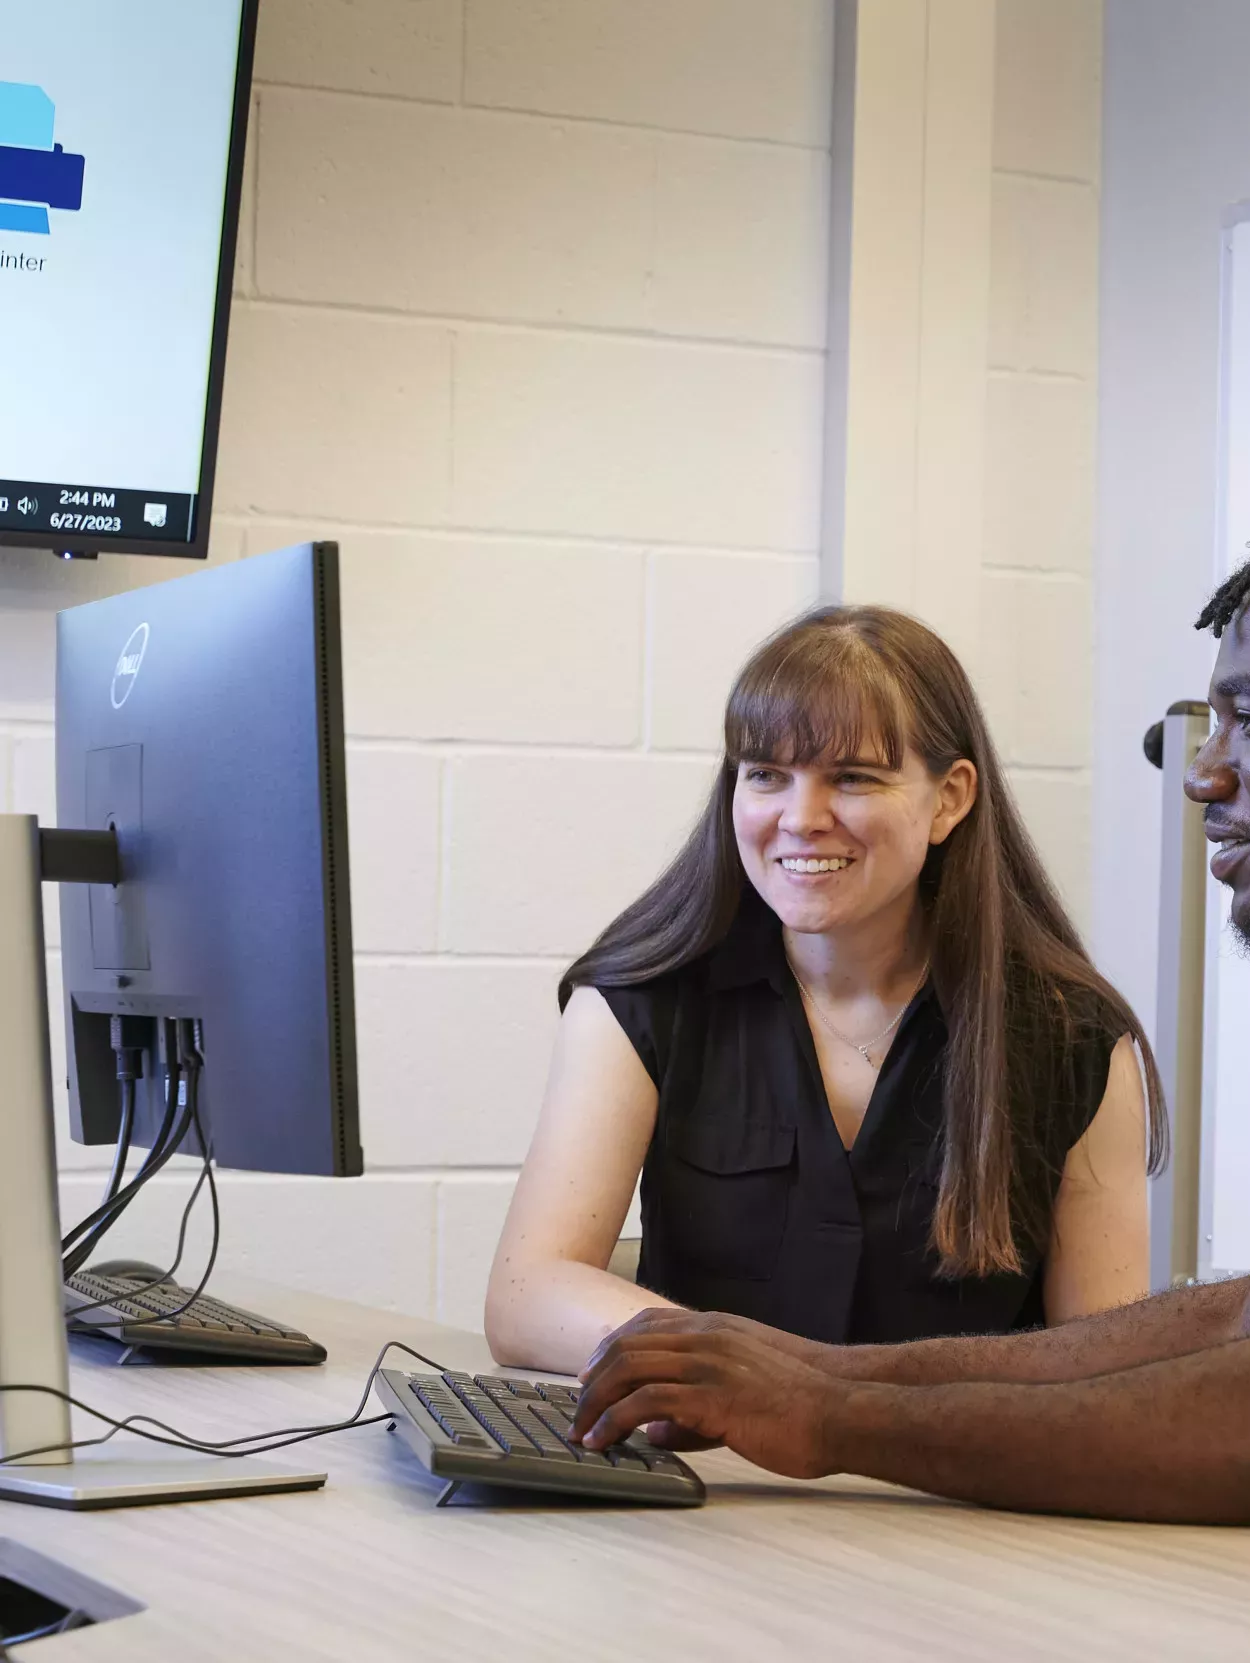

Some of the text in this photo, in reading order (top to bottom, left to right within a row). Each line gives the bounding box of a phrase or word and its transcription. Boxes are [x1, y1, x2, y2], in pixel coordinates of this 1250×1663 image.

[0, 250, 47, 272] inter
[59, 489, 116, 508] 2:44 PM
[50, 512, 122, 532] 6/27/2023
